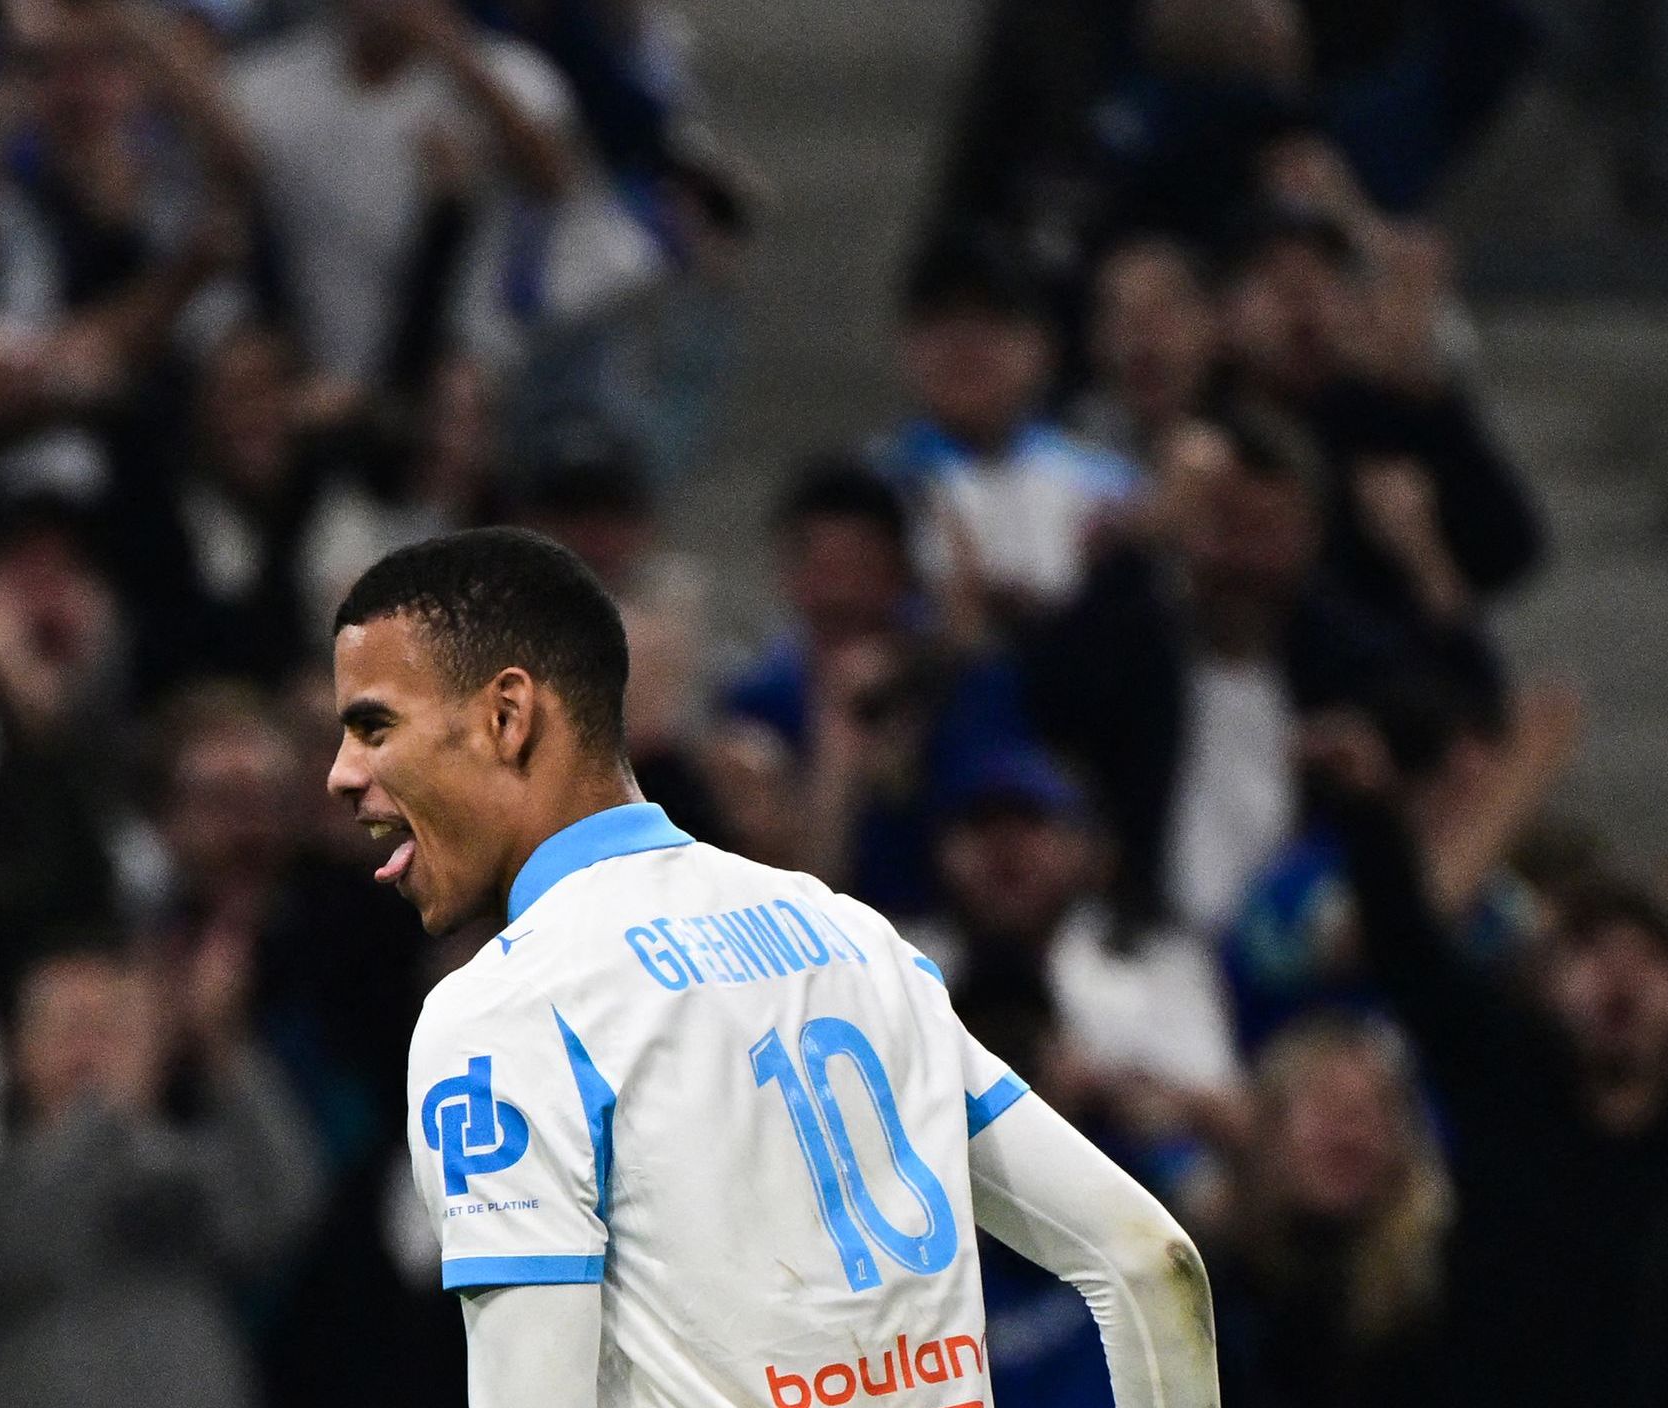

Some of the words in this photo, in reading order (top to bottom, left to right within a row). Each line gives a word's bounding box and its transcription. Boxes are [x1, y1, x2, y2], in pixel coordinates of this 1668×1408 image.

[467, 1203, 485, 1215] DE
[488, 1199, 540, 1213] PLATINE
[748, 1017, 958, 1294] 10
